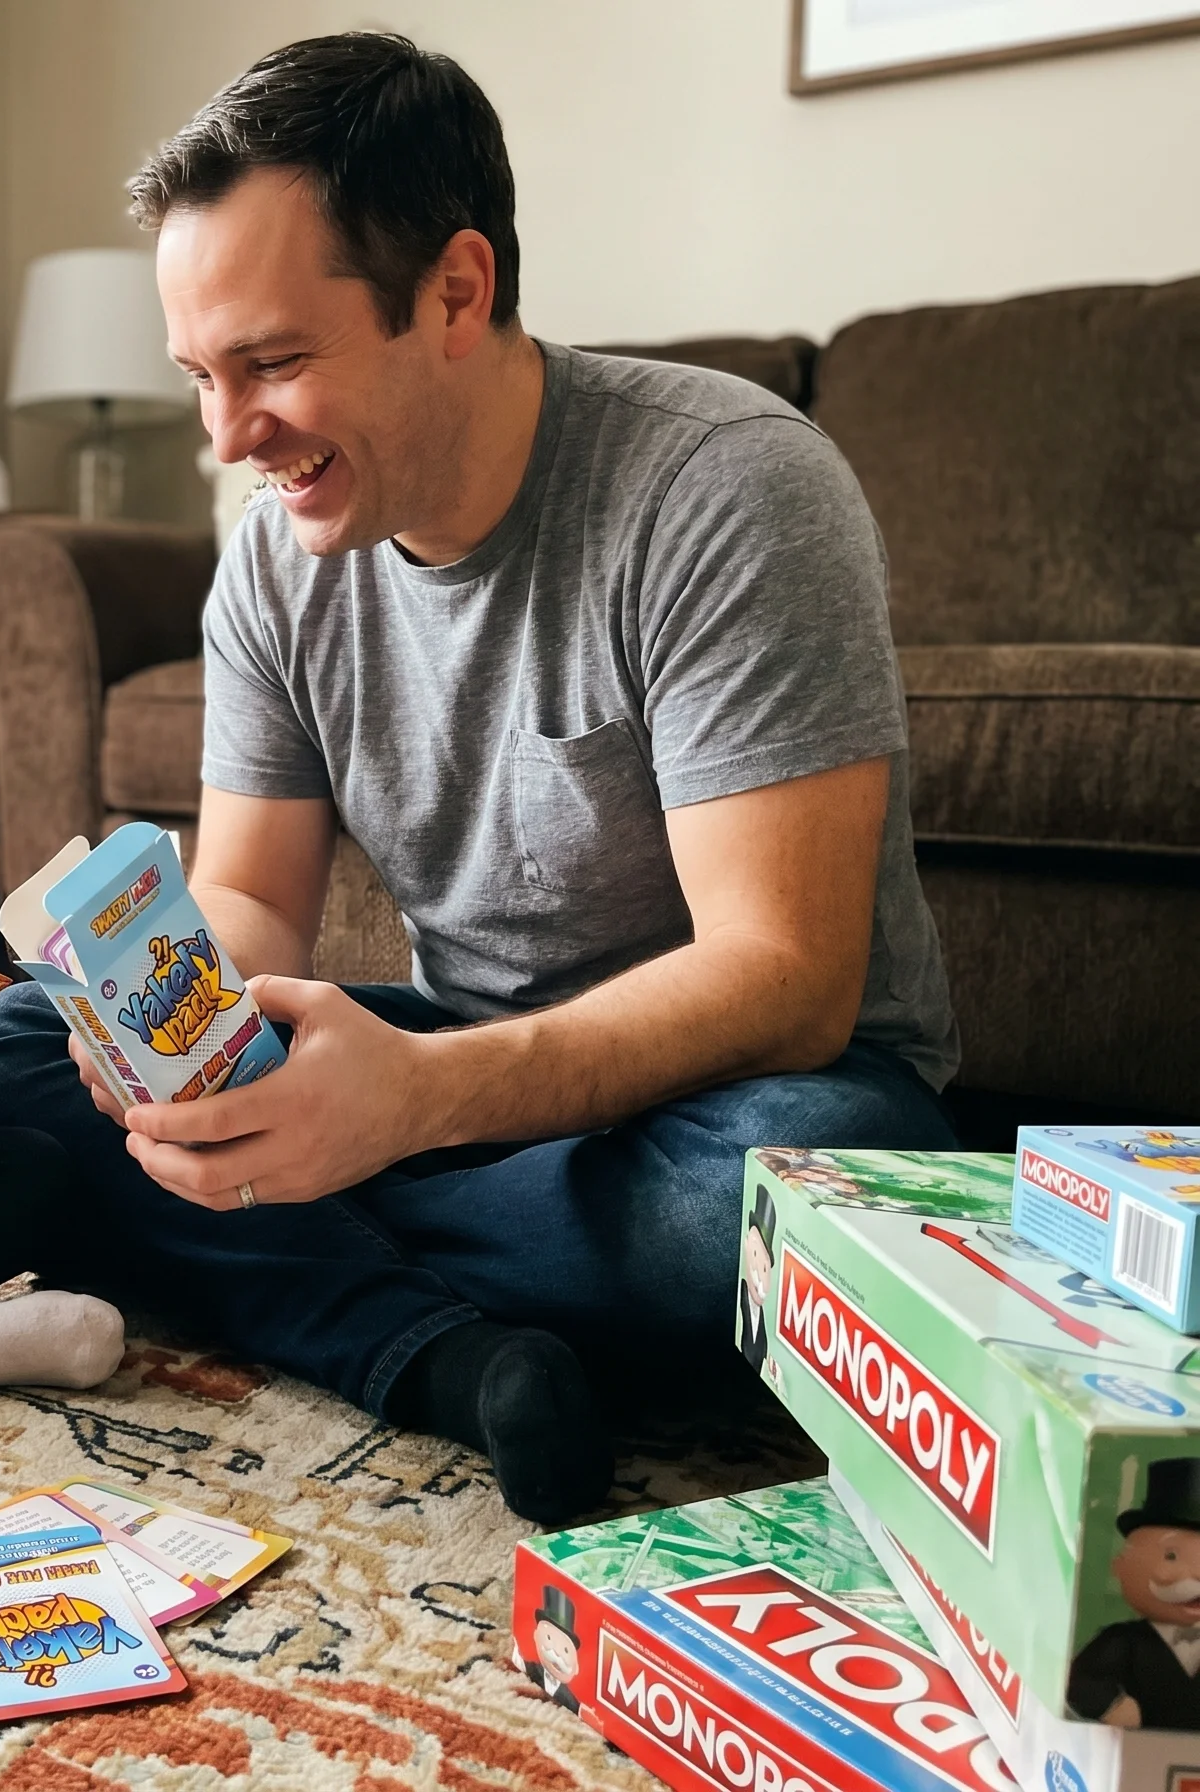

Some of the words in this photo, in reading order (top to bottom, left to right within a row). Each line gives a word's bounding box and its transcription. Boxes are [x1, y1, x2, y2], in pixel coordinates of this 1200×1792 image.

[1023, 1152, 1109, 1216] MONOPOLY
[783, 1267, 991, 1515] MONOPOLY
[607, 1650, 816, 1792] MONOP
